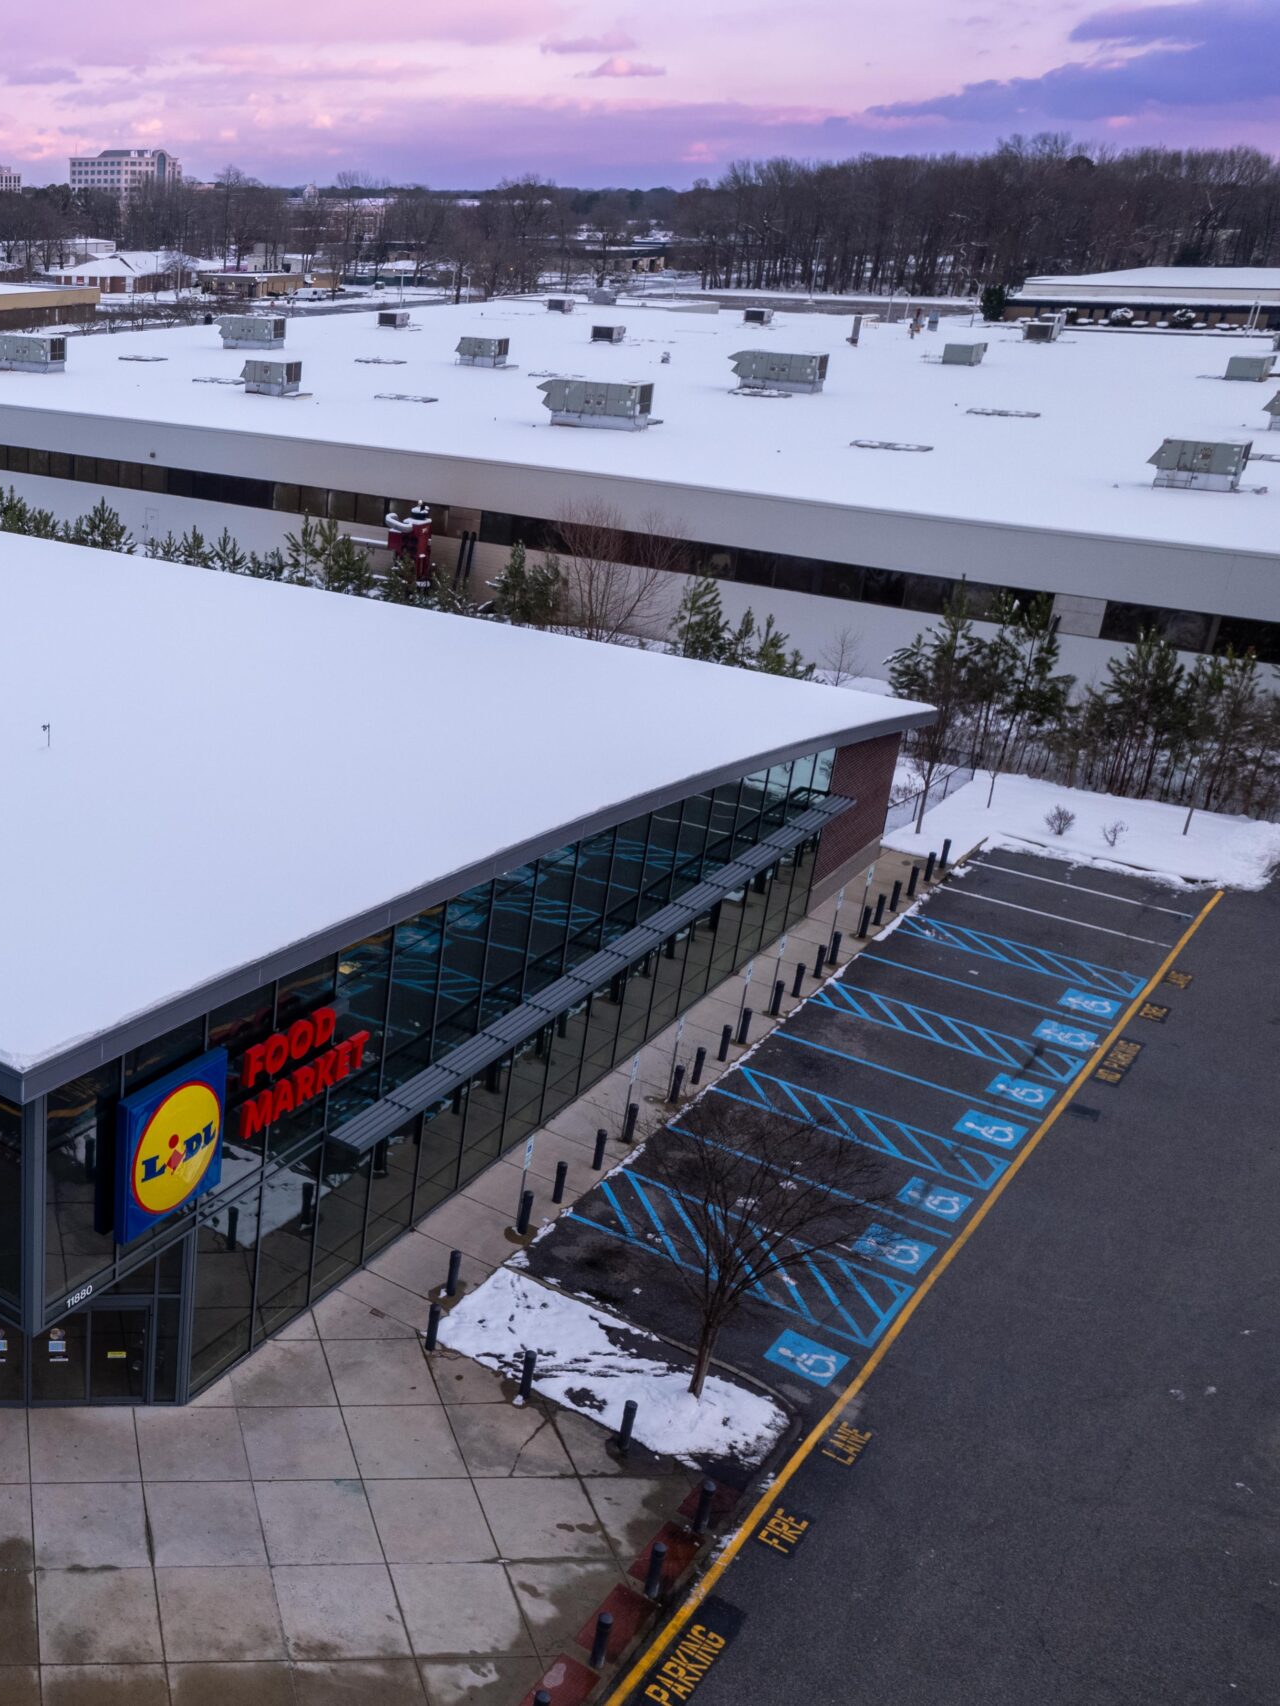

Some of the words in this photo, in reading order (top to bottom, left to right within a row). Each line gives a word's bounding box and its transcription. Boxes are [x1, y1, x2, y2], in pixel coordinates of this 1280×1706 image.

[241, 1007, 336, 1088] FOOD
[239, 1030, 370, 1139] MARKET
[66, 1284, 93, 1308] 11880
[821, 1421, 872, 1465] LANE
[758, 1507, 809, 1553] FIRE
[645, 1624, 726, 1706] PARKING
